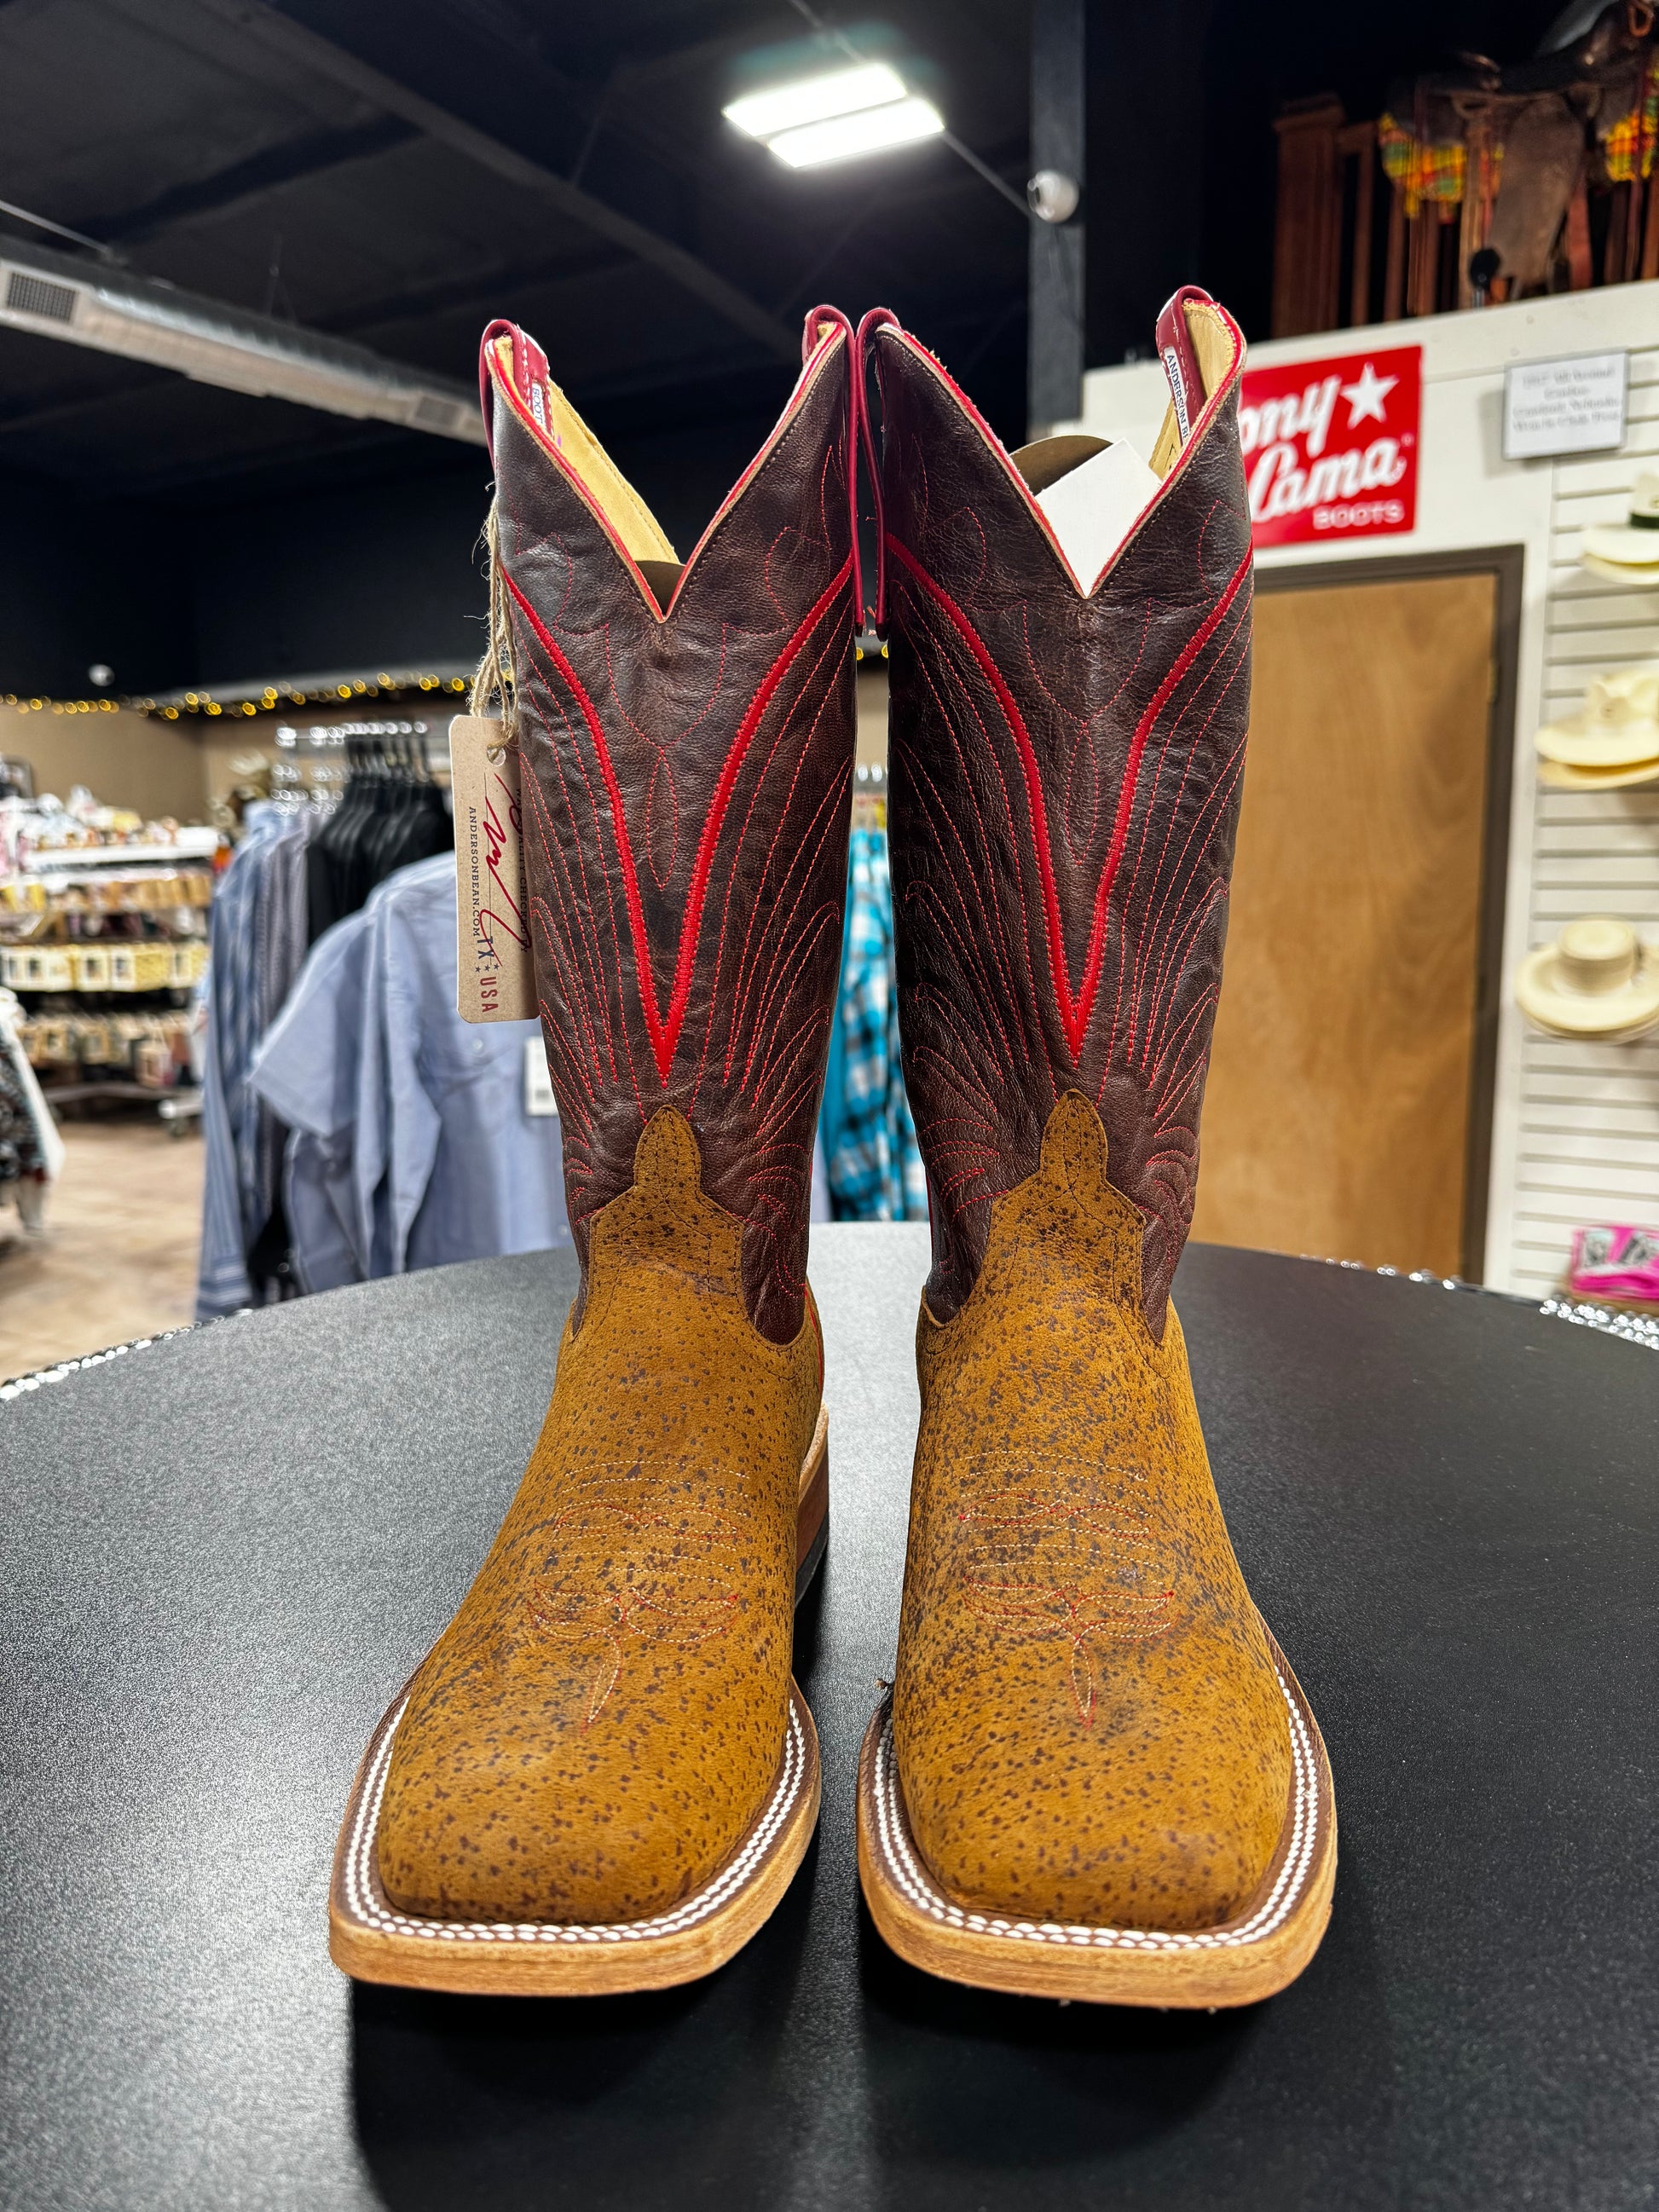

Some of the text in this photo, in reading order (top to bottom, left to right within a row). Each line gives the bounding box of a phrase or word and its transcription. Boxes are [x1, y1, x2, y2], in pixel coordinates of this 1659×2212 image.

[1167, 355, 1187, 424] ANDERSON
[1238, 373, 1342, 459] ony
[1313, 500, 1406, 530] BOOTS
[469, 806, 481, 937] ANDERSONBEAN.COM
[477, 936, 499, 1013] TX USA
